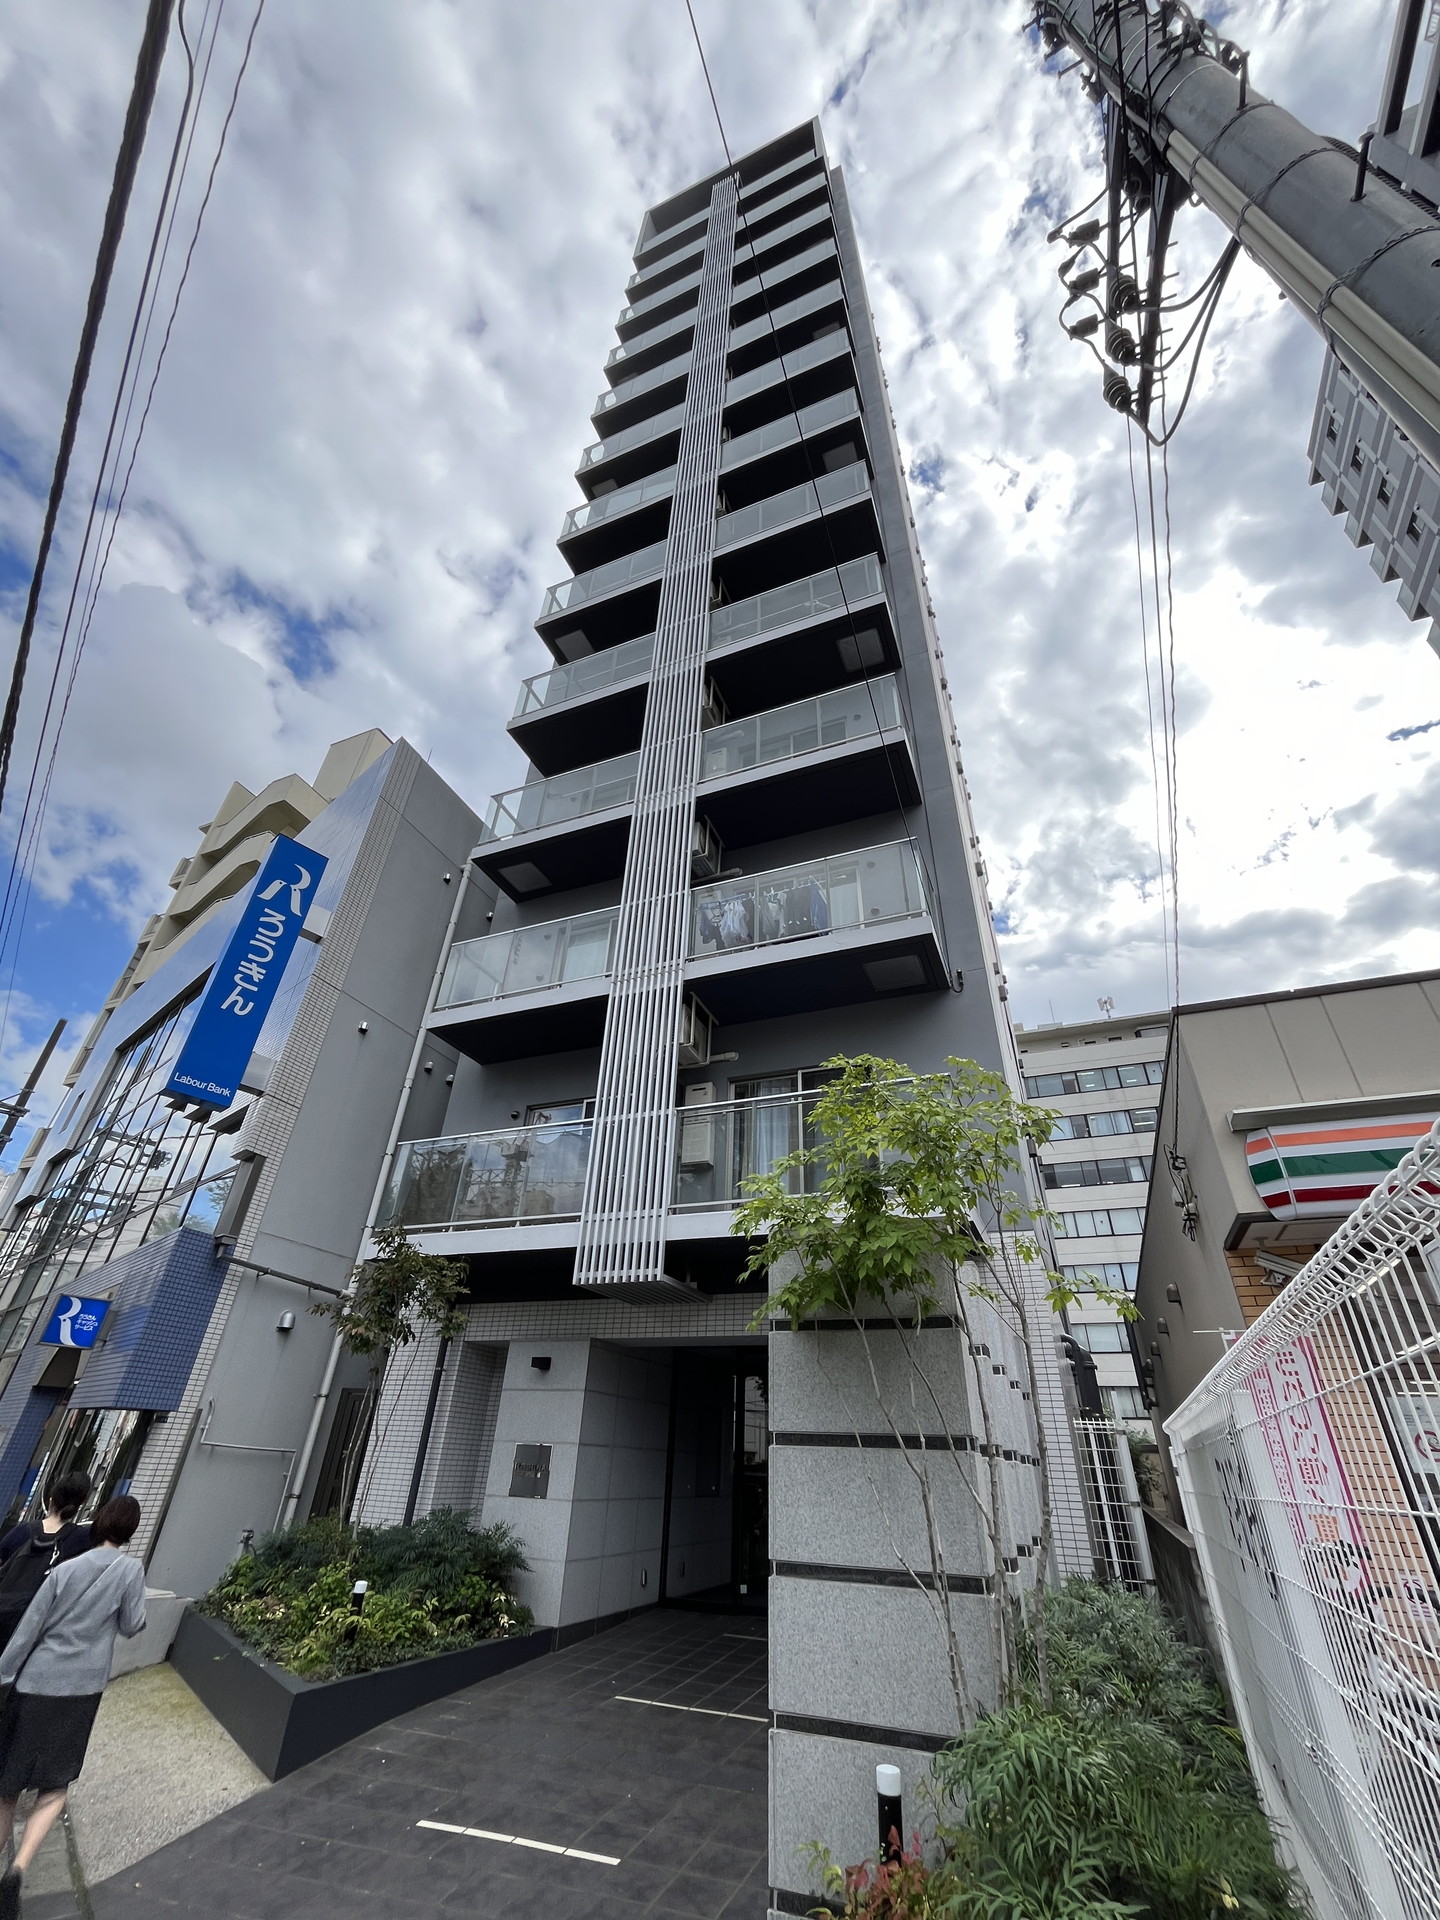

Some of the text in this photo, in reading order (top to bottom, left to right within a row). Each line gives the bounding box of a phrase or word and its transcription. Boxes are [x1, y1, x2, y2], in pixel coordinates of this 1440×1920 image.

[220, 907, 287, 1016] ろうきん
[173, 1071, 231, 1097] Labour Bank
